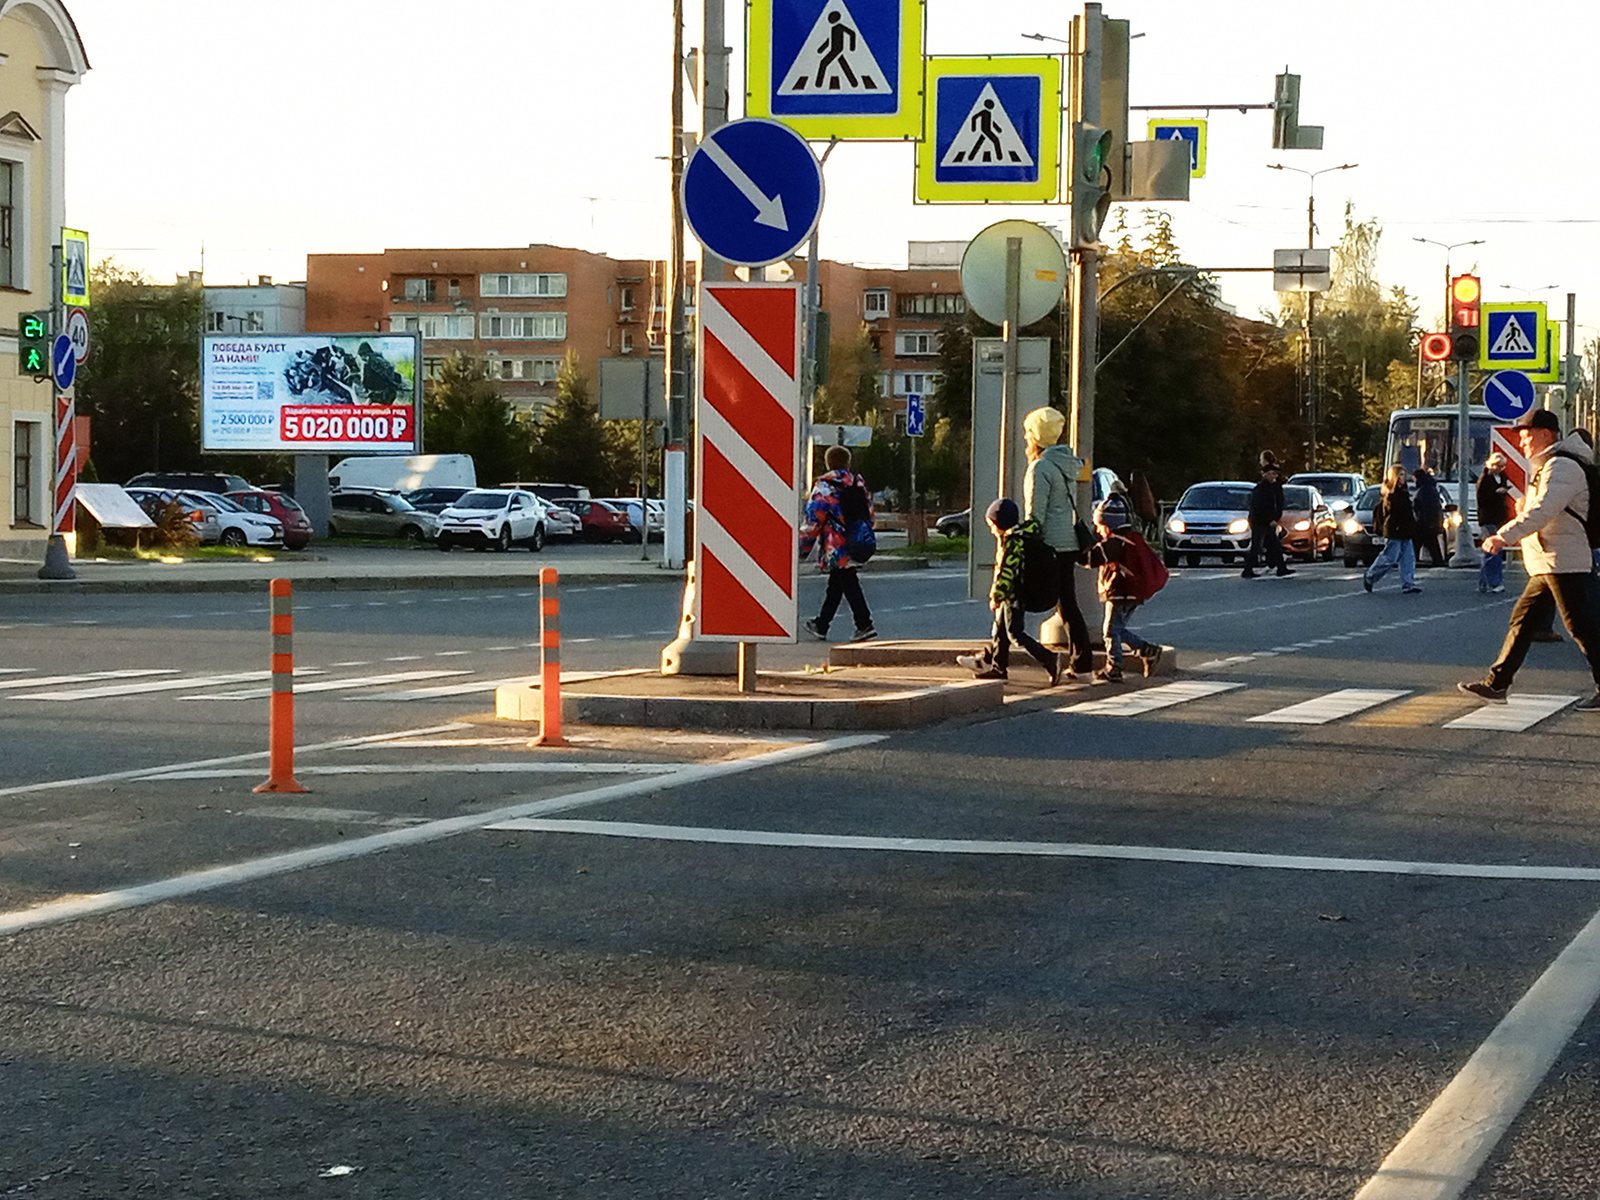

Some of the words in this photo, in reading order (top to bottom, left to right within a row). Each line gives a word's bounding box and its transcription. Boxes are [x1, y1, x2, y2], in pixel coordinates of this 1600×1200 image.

[25, 319, 43, 337] 24
[72, 326, 86, 347] 40
[212, 343, 252, 353] ПОБЕДА
[254, 343, 287, 353] БУДЕТ
[212, 354, 225, 363] ЗА
[227, 354, 259, 363] НАМИ!
[285, 407, 329, 416] Заработная
[363, 407, 391, 416] первый
[392, 408, 406, 416] год
[221, 414, 227, 425] 2
[228, 414, 246, 425] 500
[248, 414, 267, 424] 000
[285, 417, 299, 438] 5
[302, 417, 343, 438] 020
[347, 417, 388, 438] 000
[391, 417, 407, 438] ₽
